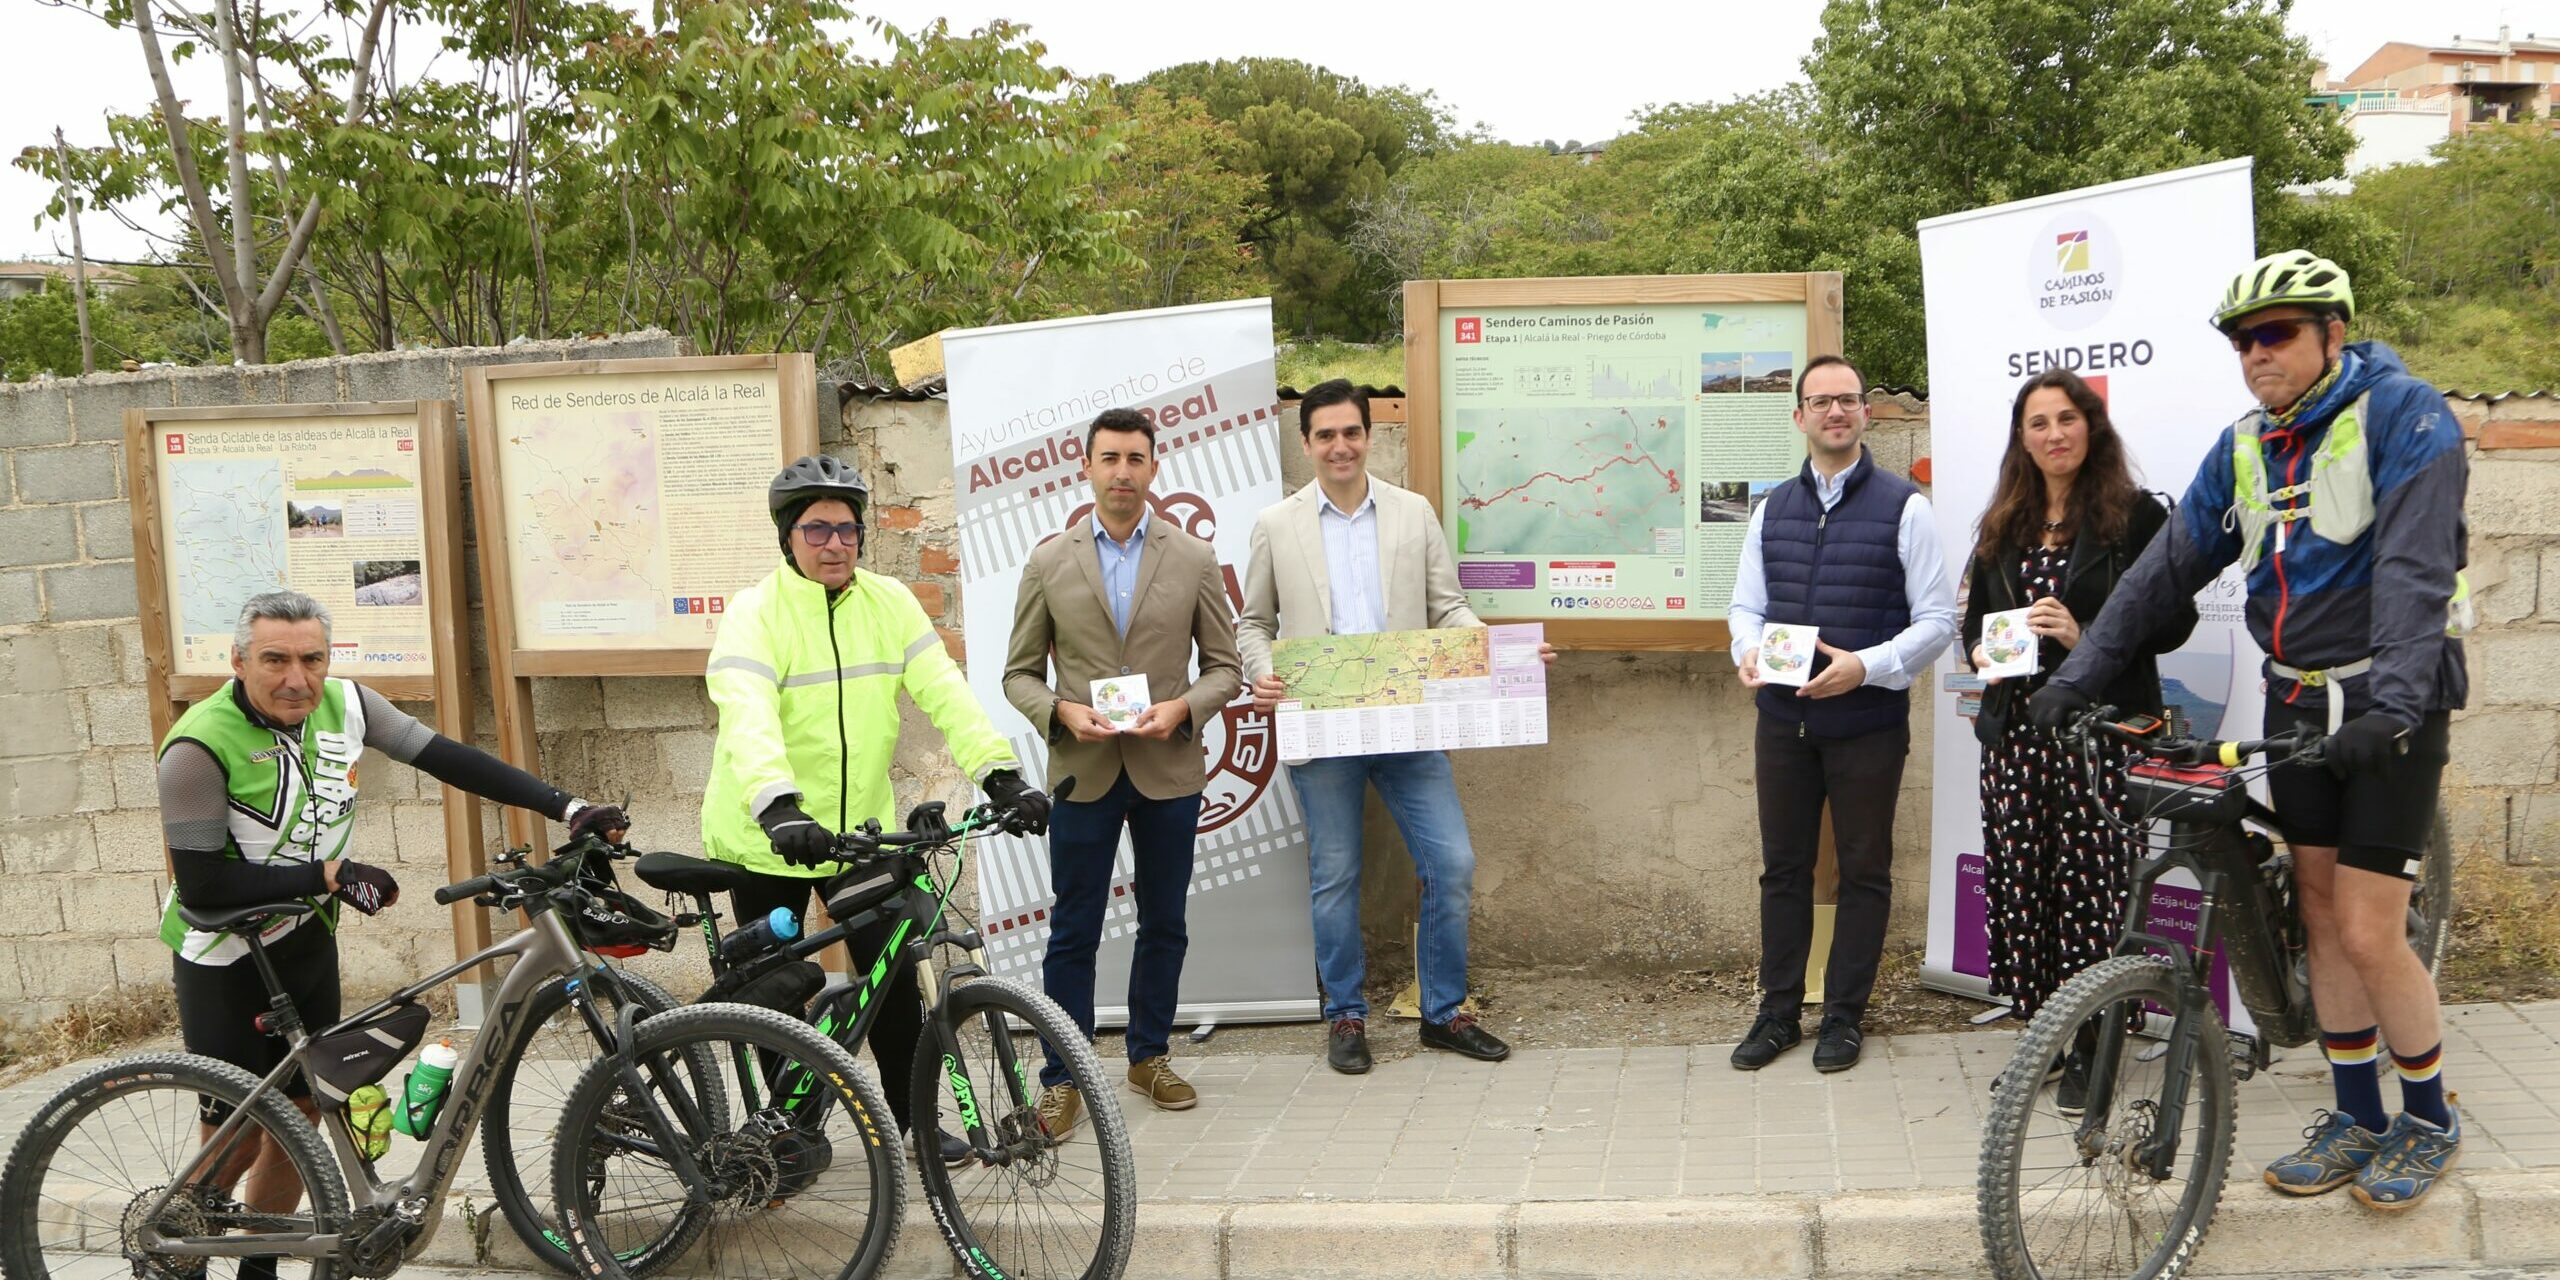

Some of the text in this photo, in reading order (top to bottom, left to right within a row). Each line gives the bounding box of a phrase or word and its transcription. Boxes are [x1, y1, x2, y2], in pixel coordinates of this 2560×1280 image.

[2044, 272, 2105, 291] CAMINOS
[2040, 287, 2113, 308] DE PASIÓN
[1462, 322, 1475, 330] GR
[1485, 312, 1654, 328] Sendero Caminos de Pasión
[1461, 332, 1476, 340] 341
[1485, 334, 1511, 344] Etapa
[1525, 333, 1550, 342] Alcalá
[1552, 333, 1560, 342] la
[1561, 332, 1580, 341] Real
[1587, 332, 1614, 343] Priego
[1617, 332, 1628, 341] de
[1629, 330, 1666, 340] Córdoba
[2008, 339, 2154, 378] SENDERO
[511, 381, 766, 410] Red de Senderos de Alcalá la Real
[960, 355, 1206, 457] Ayuntamiento de
[187, 425, 412, 445] Senda Ciclable de las aldeas de Alcalá la Real
[969, 383, 1219, 494] Alcalá Real
[188, 446, 211, 455] Etapa
[222, 444, 246, 453] Alcalá
[247, 444, 255, 453] la
[256, 443, 273, 452] Real
[280, 443, 290, 452] La
[1961, 863, 1985, 875] Alcal
[1973, 884, 1987, 895] Os
[2180, 919, 2198, 931] Utr
[434, 1001, 525, 1181] ORBEA
[828, 1072, 880, 1147] MAXXIS
[954, 1086, 980, 1132] FOX
[931, 1195, 982, 1276] FAST LANE
[2155, 1225, 2200, 1280] MAXX
